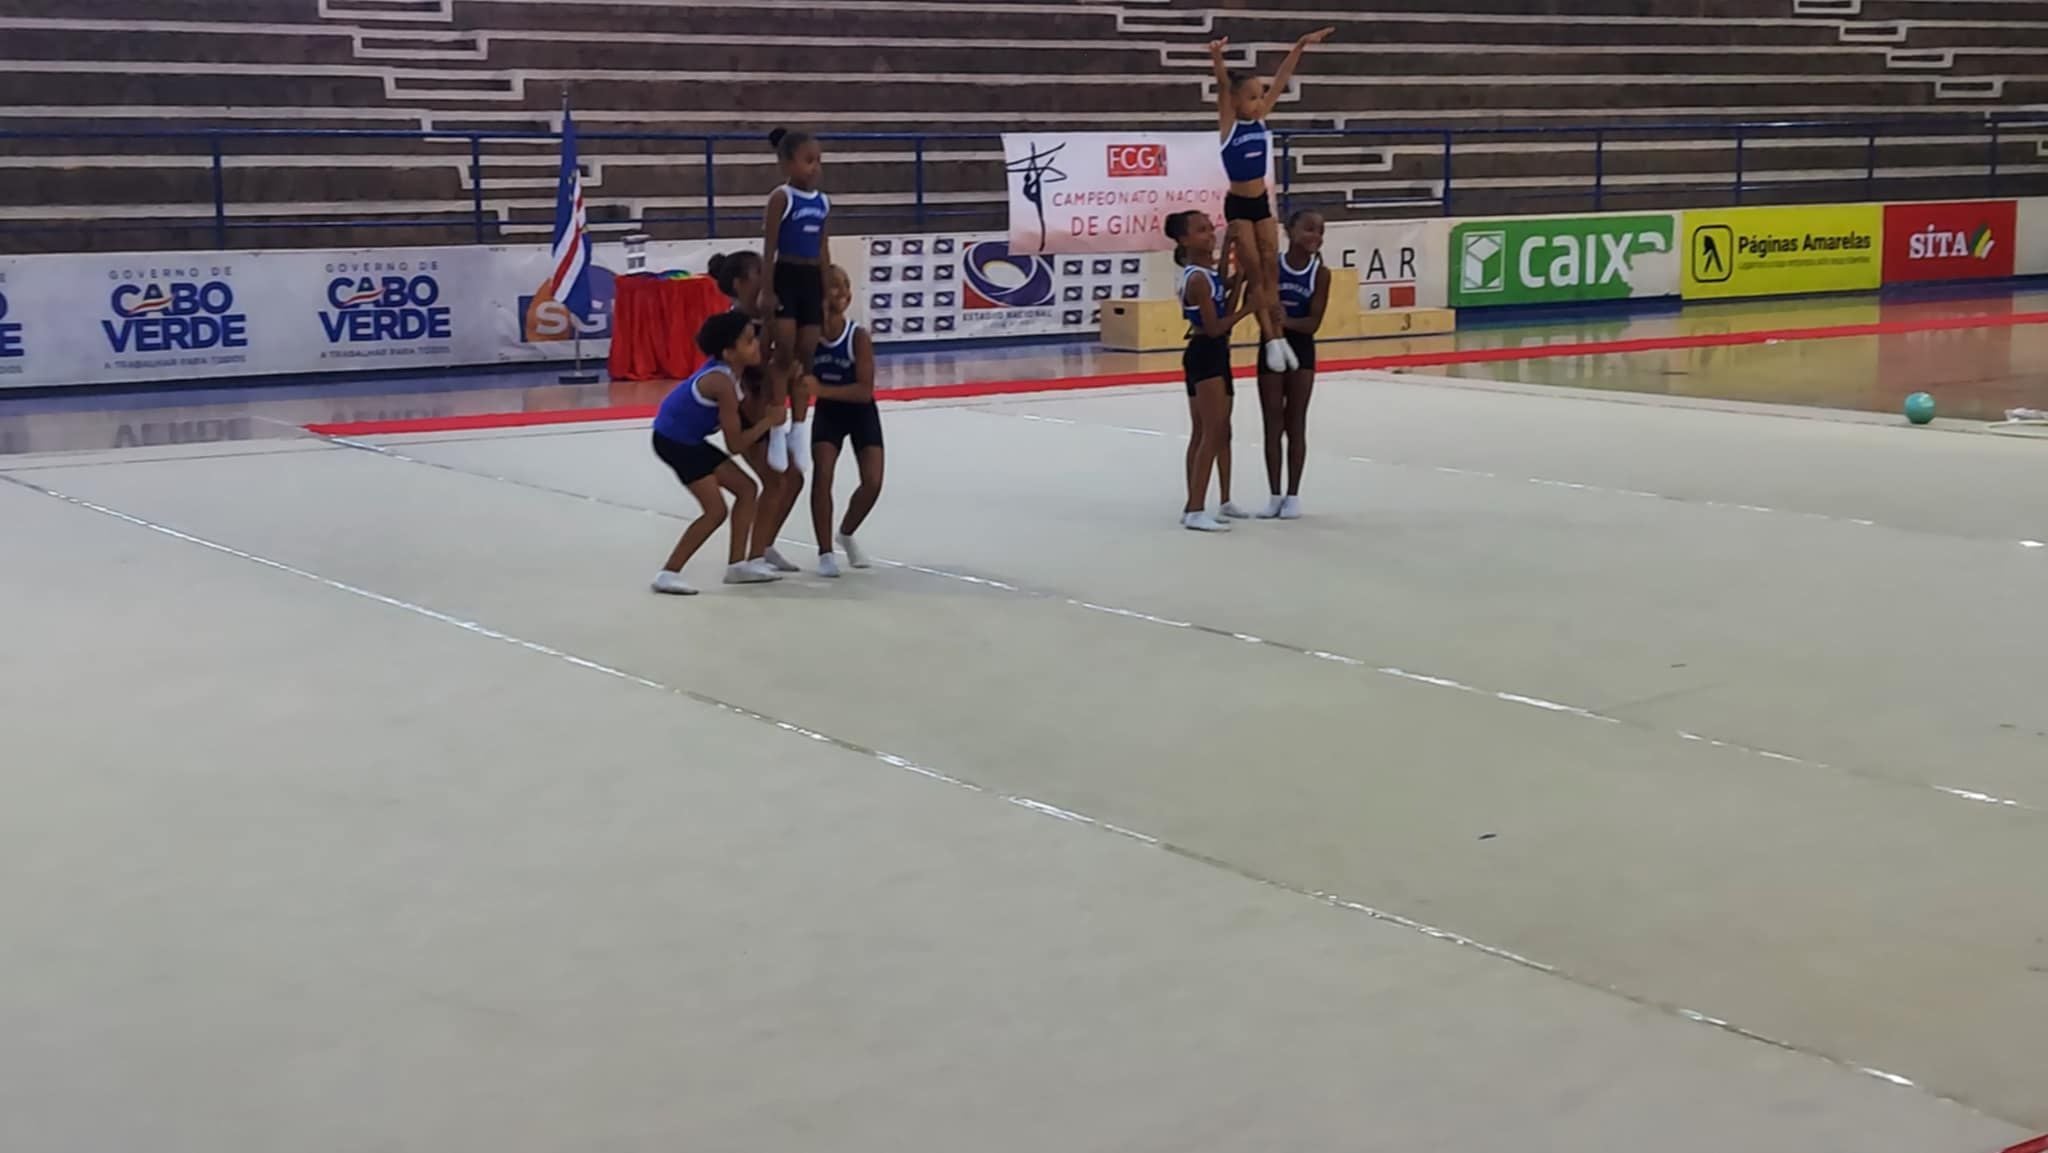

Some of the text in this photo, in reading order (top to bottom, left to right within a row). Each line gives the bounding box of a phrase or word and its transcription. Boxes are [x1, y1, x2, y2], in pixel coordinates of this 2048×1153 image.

[1109, 147, 1155, 169] FCG
[1052, 189, 1222, 207] CAMPEONATO NACION
[1071, 216, 1099, 236] DE
[1738, 230, 1871, 258] Páginas Amarelas
[1908, 224, 1969, 259] SÍTA
[109, 266, 233, 280] GOVERNO DE
[326, 261, 438, 273] GOVERNO DE
[111, 281, 234, 318] CABO
[327, 275, 439, 310] CABO
[101, 313, 248, 353] VERDE
[318, 306, 452, 343] VERDE
